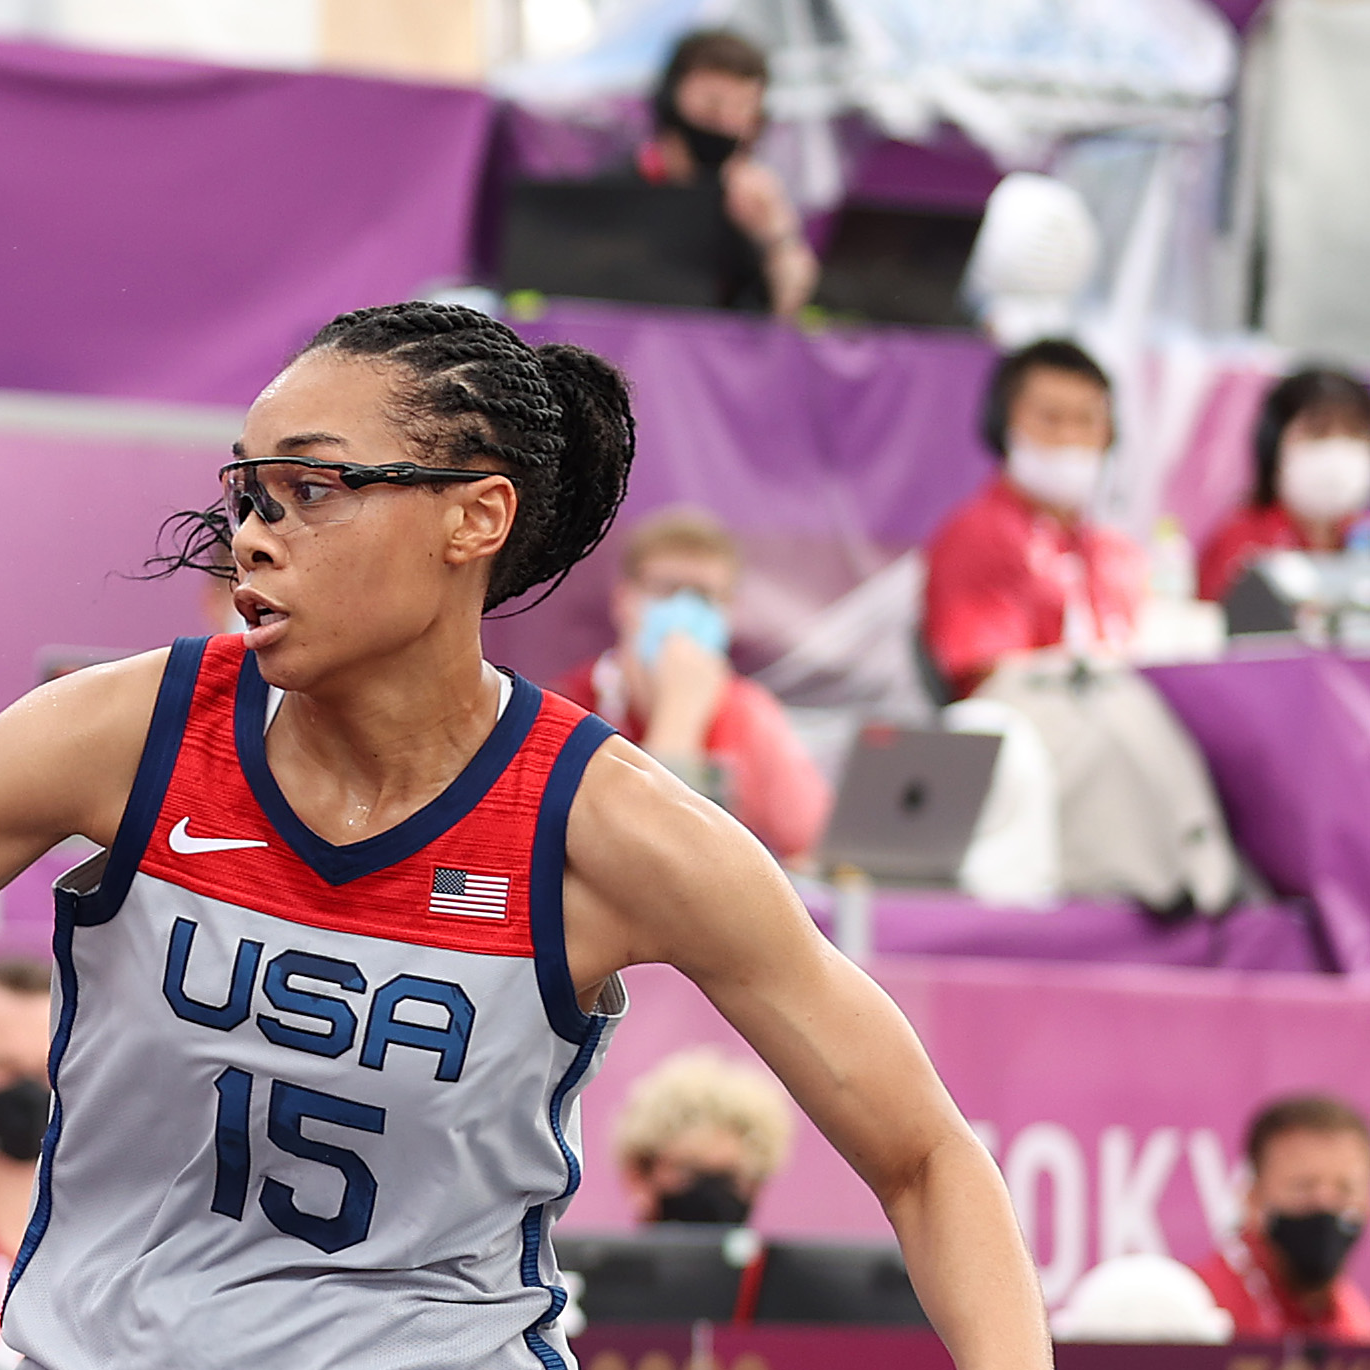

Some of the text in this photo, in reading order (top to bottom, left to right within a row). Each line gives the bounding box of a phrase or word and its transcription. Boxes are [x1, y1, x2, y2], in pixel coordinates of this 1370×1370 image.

[162, 916, 476, 1083] USA
[211, 1065, 386, 1255] 15
[974, 1119, 1257, 1307] OKY
